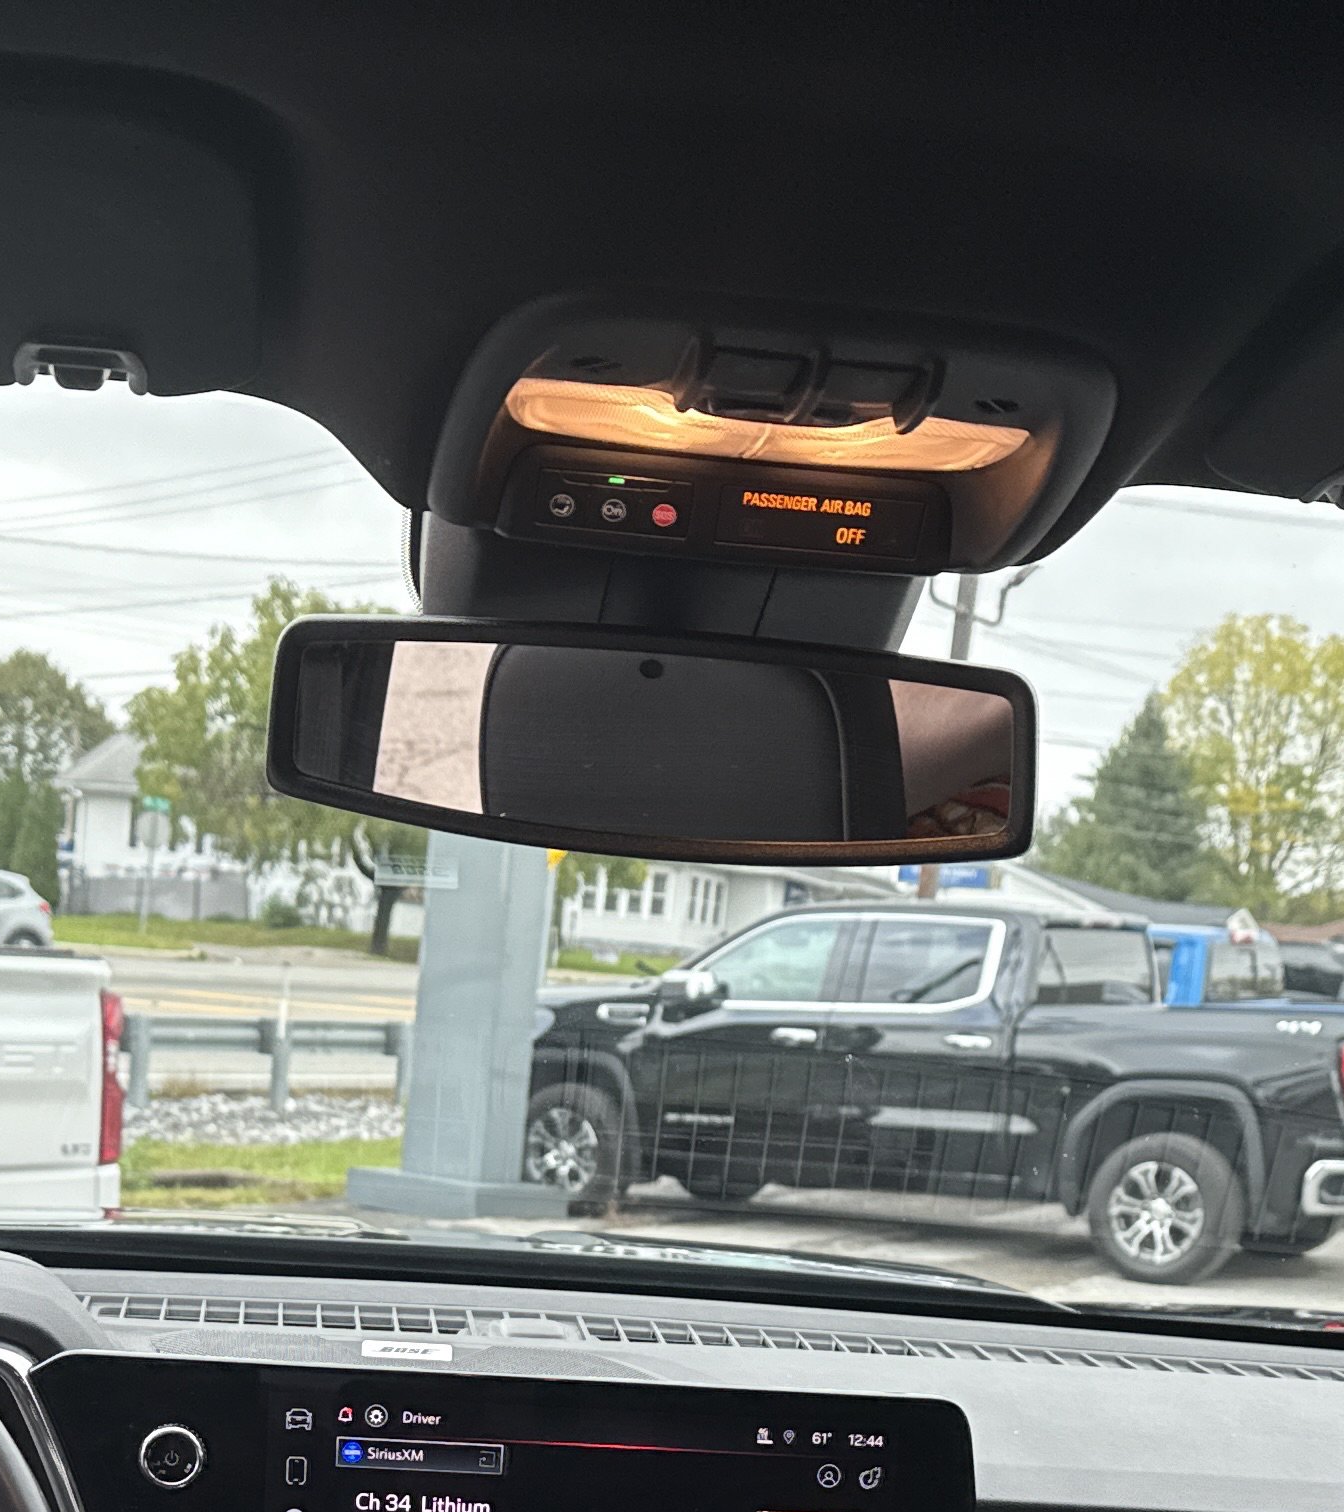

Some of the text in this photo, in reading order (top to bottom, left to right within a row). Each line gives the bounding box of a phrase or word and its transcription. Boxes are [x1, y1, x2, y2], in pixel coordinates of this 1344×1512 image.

[743, 492, 871, 516] PASSENGER AIR BAG
[836, 528, 866, 545] OFF
[378, 1346, 441, 1356] BOSE
[403, 1410, 441, 1426] Driver
[848, 1433, 884, 1448] 12:44
[367, 1447, 424, 1463] SiriusXM
[355, 1492, 380, 1511] Ch
[385, 1494, 411, 1512] 34
